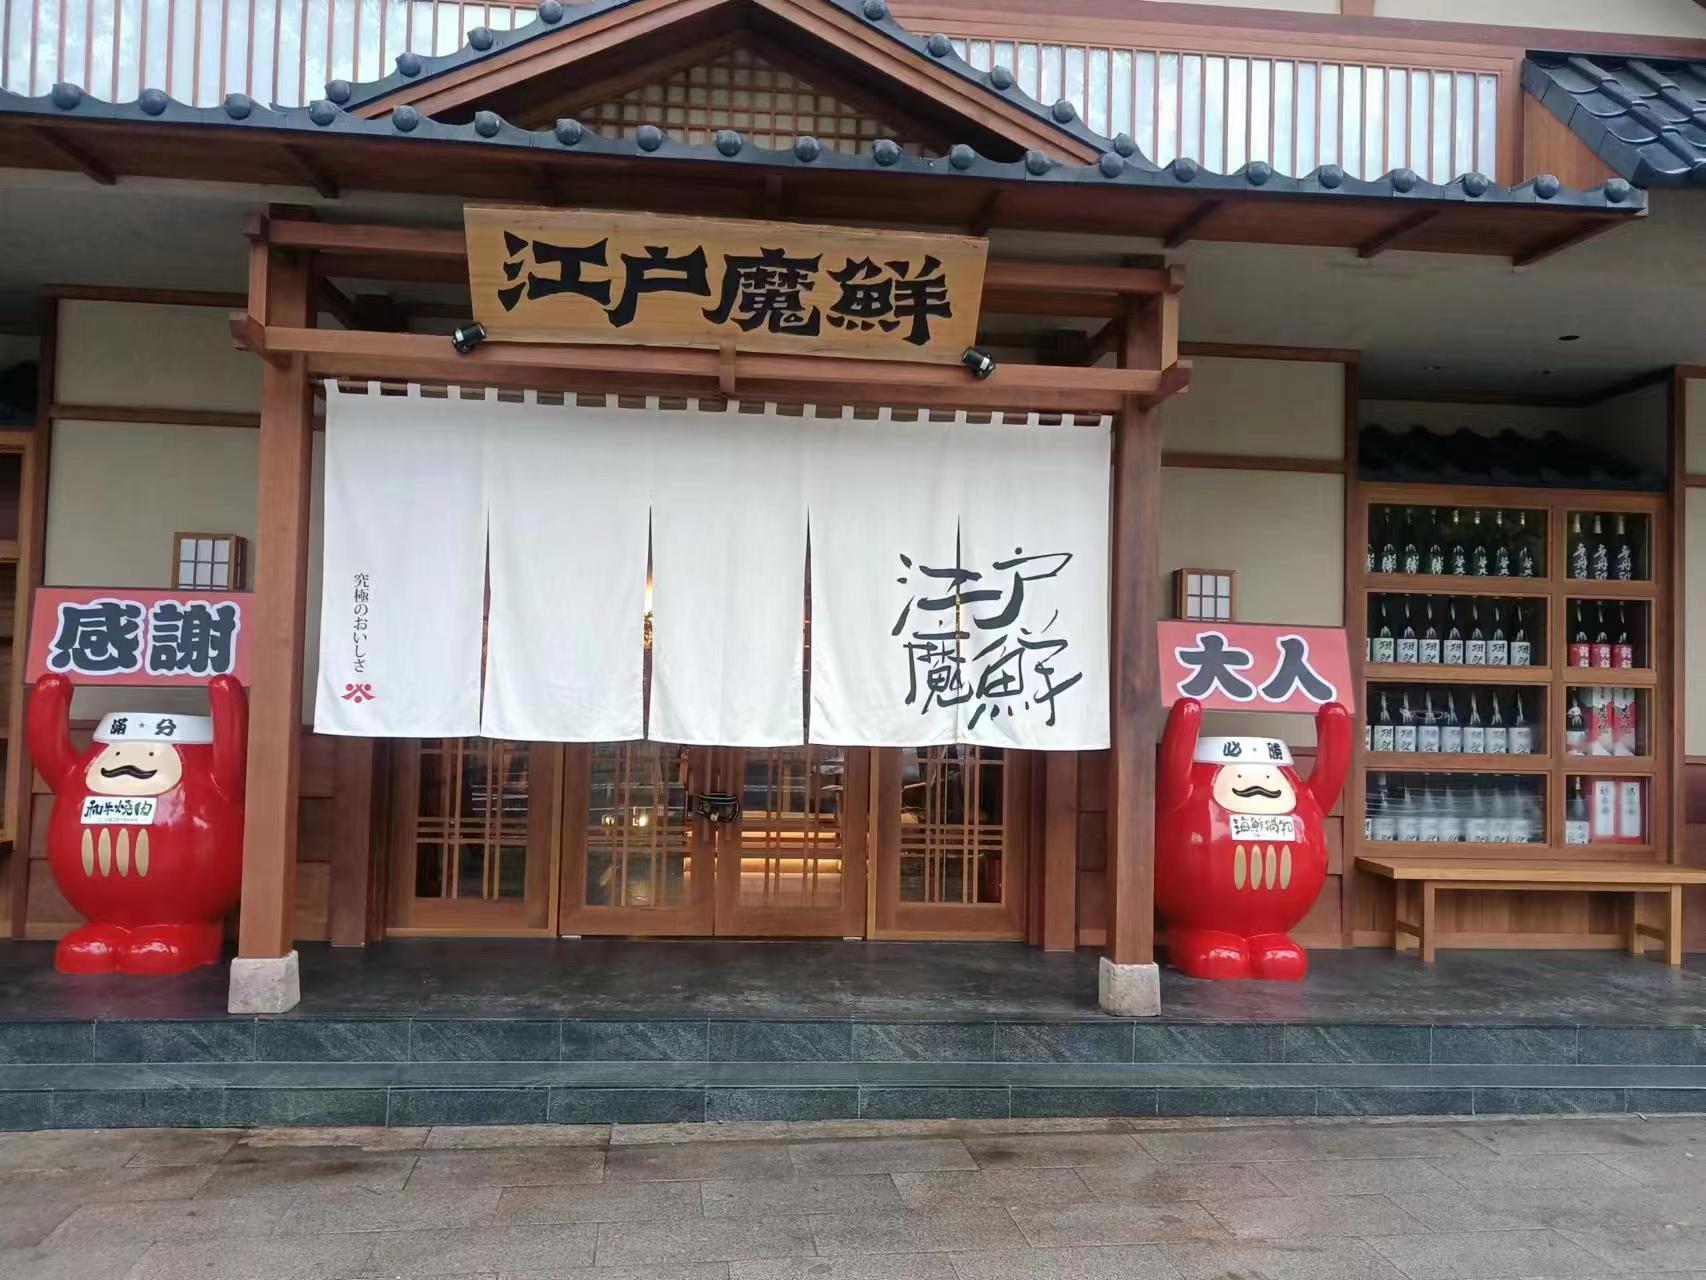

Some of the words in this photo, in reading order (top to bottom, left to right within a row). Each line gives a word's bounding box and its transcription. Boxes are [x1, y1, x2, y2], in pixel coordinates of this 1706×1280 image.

[48, 599, 239, 676] 感謝
[353, 572, 370, 673] 究極のおいしさ
[1175, 632, 1337, 704] 大人
